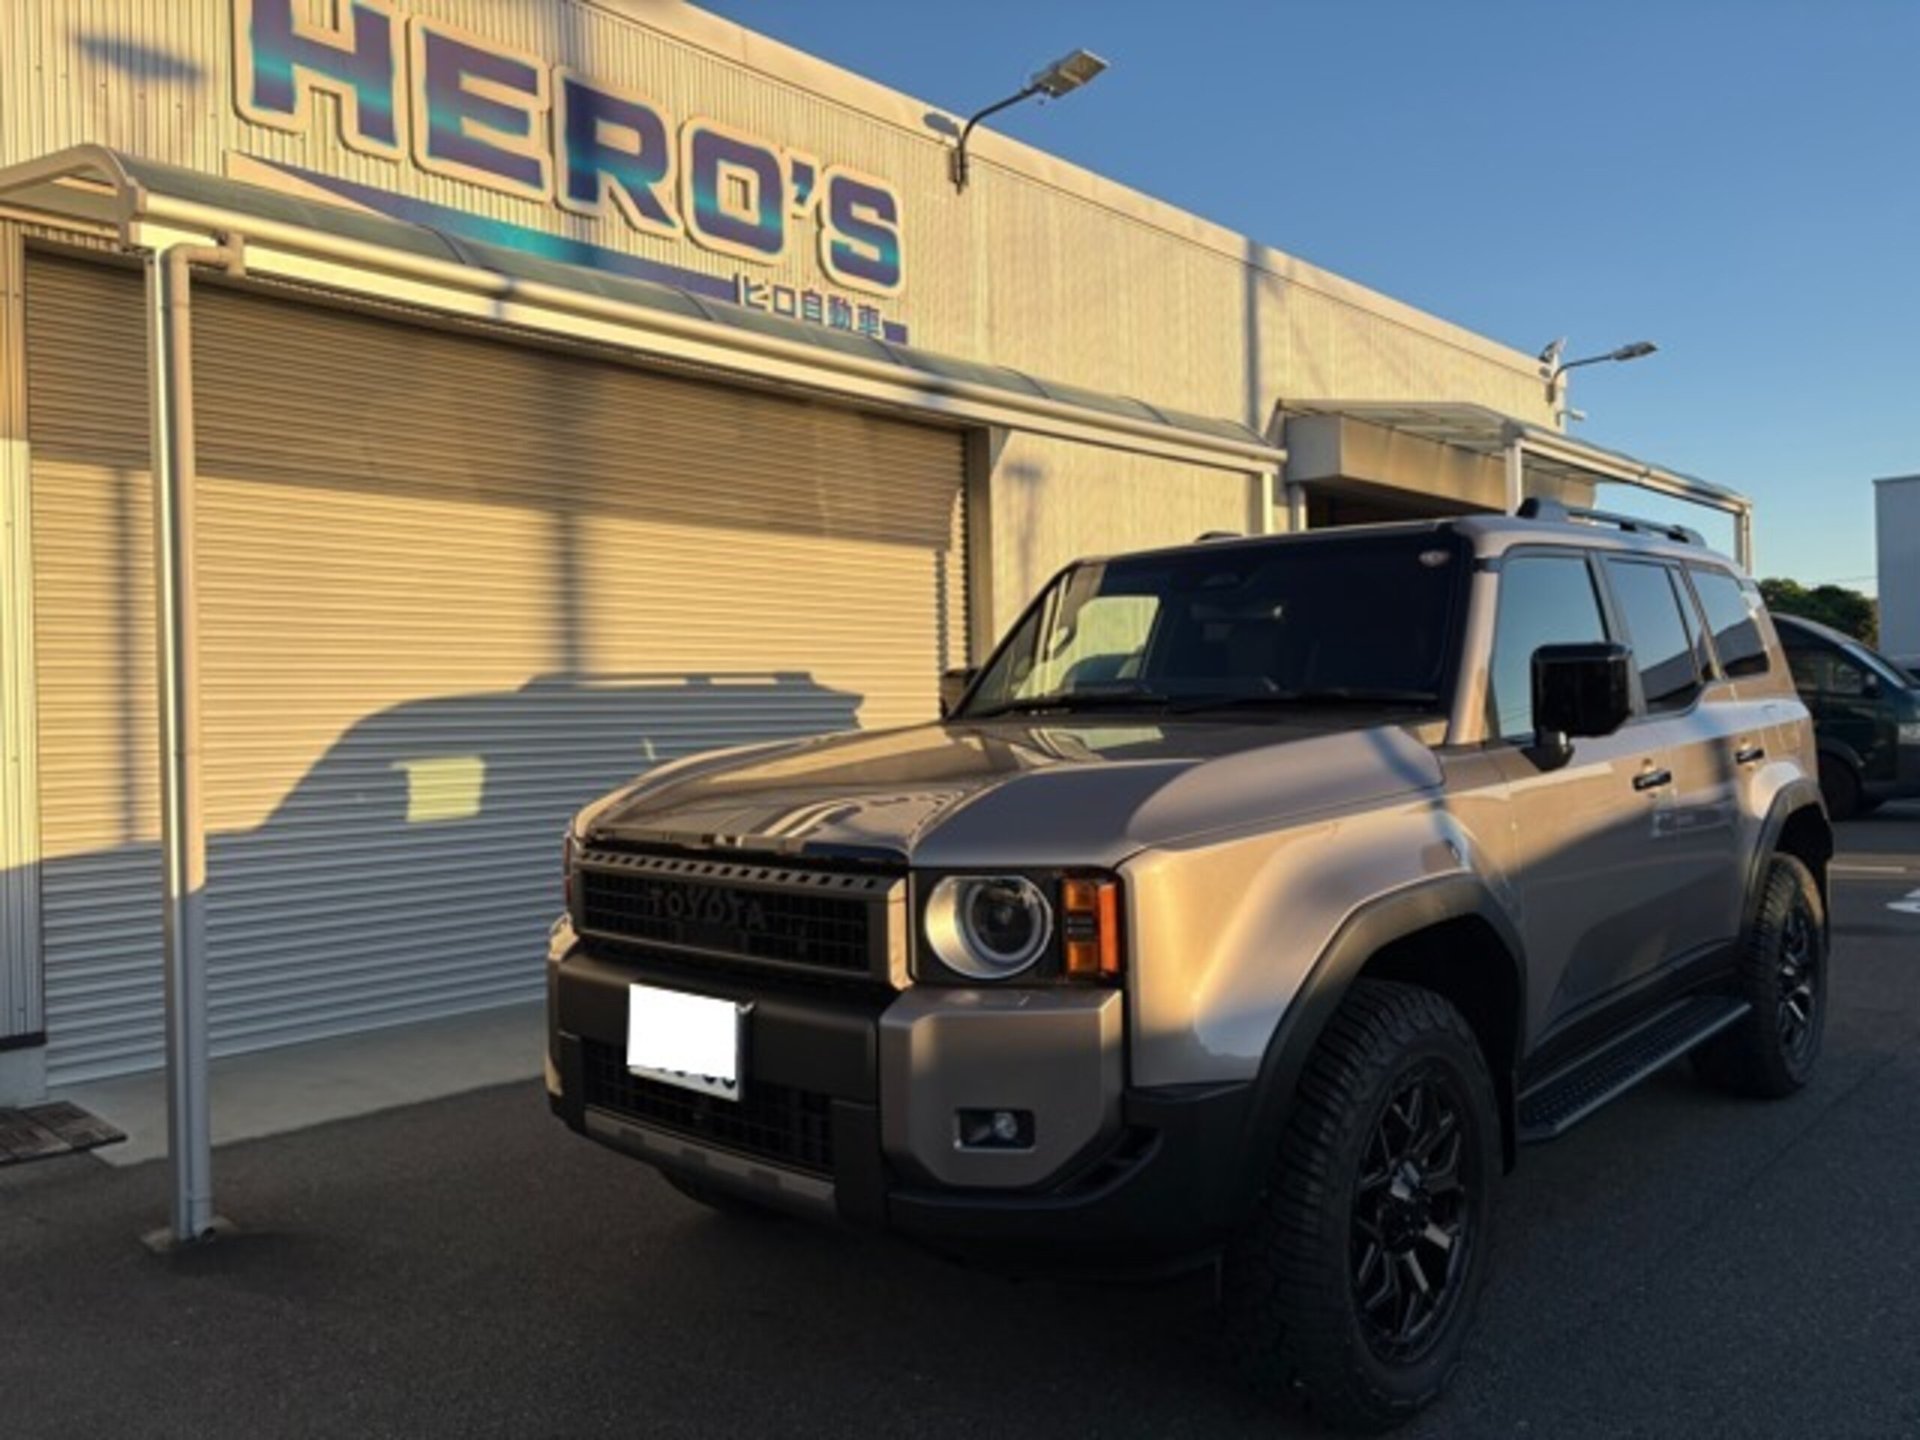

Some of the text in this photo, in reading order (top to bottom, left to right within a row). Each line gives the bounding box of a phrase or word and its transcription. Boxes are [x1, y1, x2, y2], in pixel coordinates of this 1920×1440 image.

[246, 0, 902, 290] HERO'S
[743, 275, 880, 338] ヒロ自動車
[650, 886, 767, 930] TOYOTA
